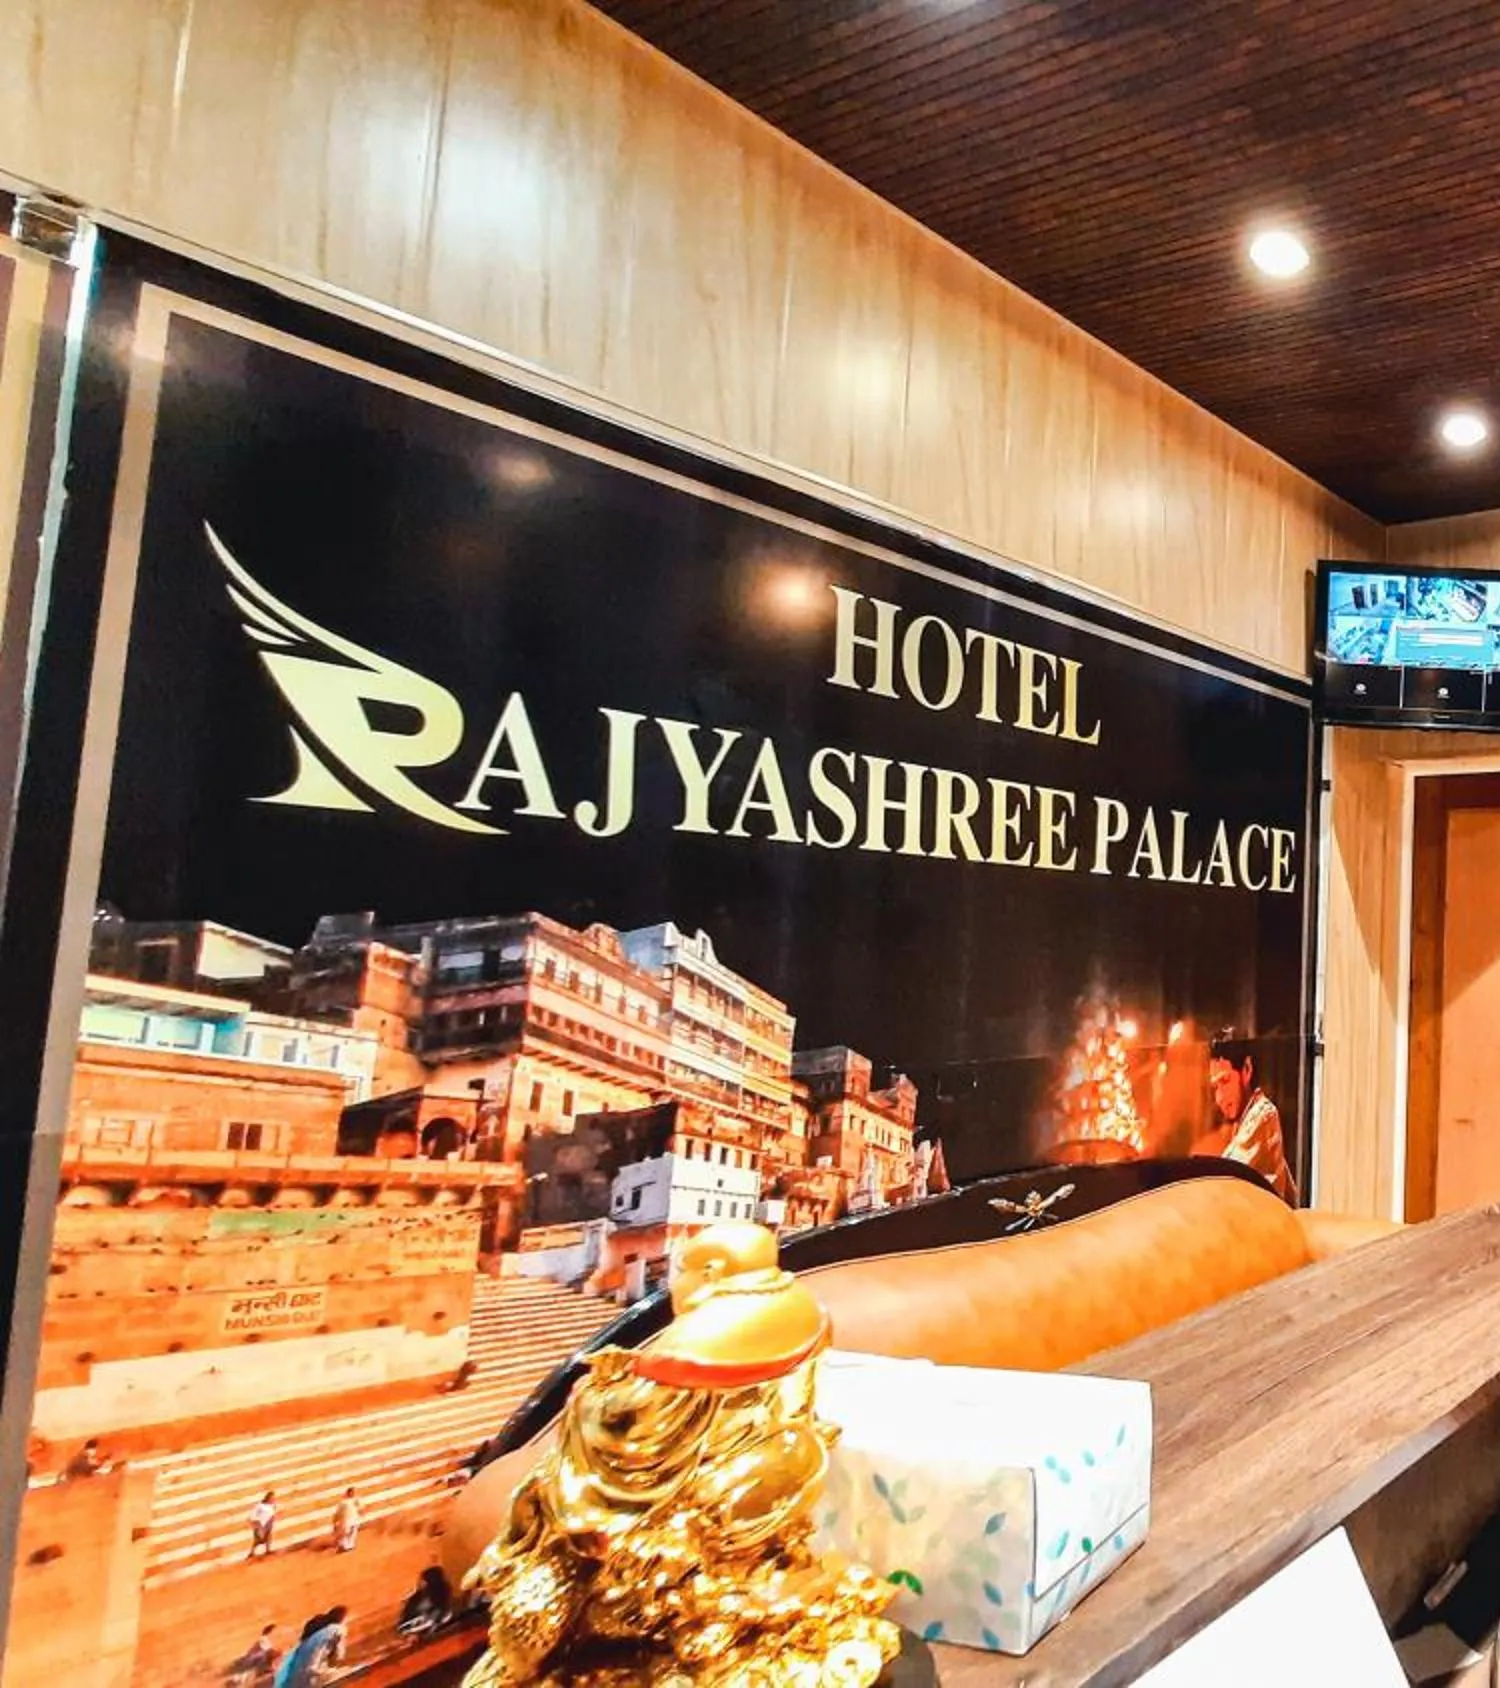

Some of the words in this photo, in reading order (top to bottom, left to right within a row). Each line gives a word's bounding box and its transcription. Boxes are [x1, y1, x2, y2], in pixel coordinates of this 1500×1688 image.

[204, 520, 1080, 873] RAJYASHREE
[1090, 796, 1296, 893] PALACE
[827, 584, 1101, 746] HOTEL
